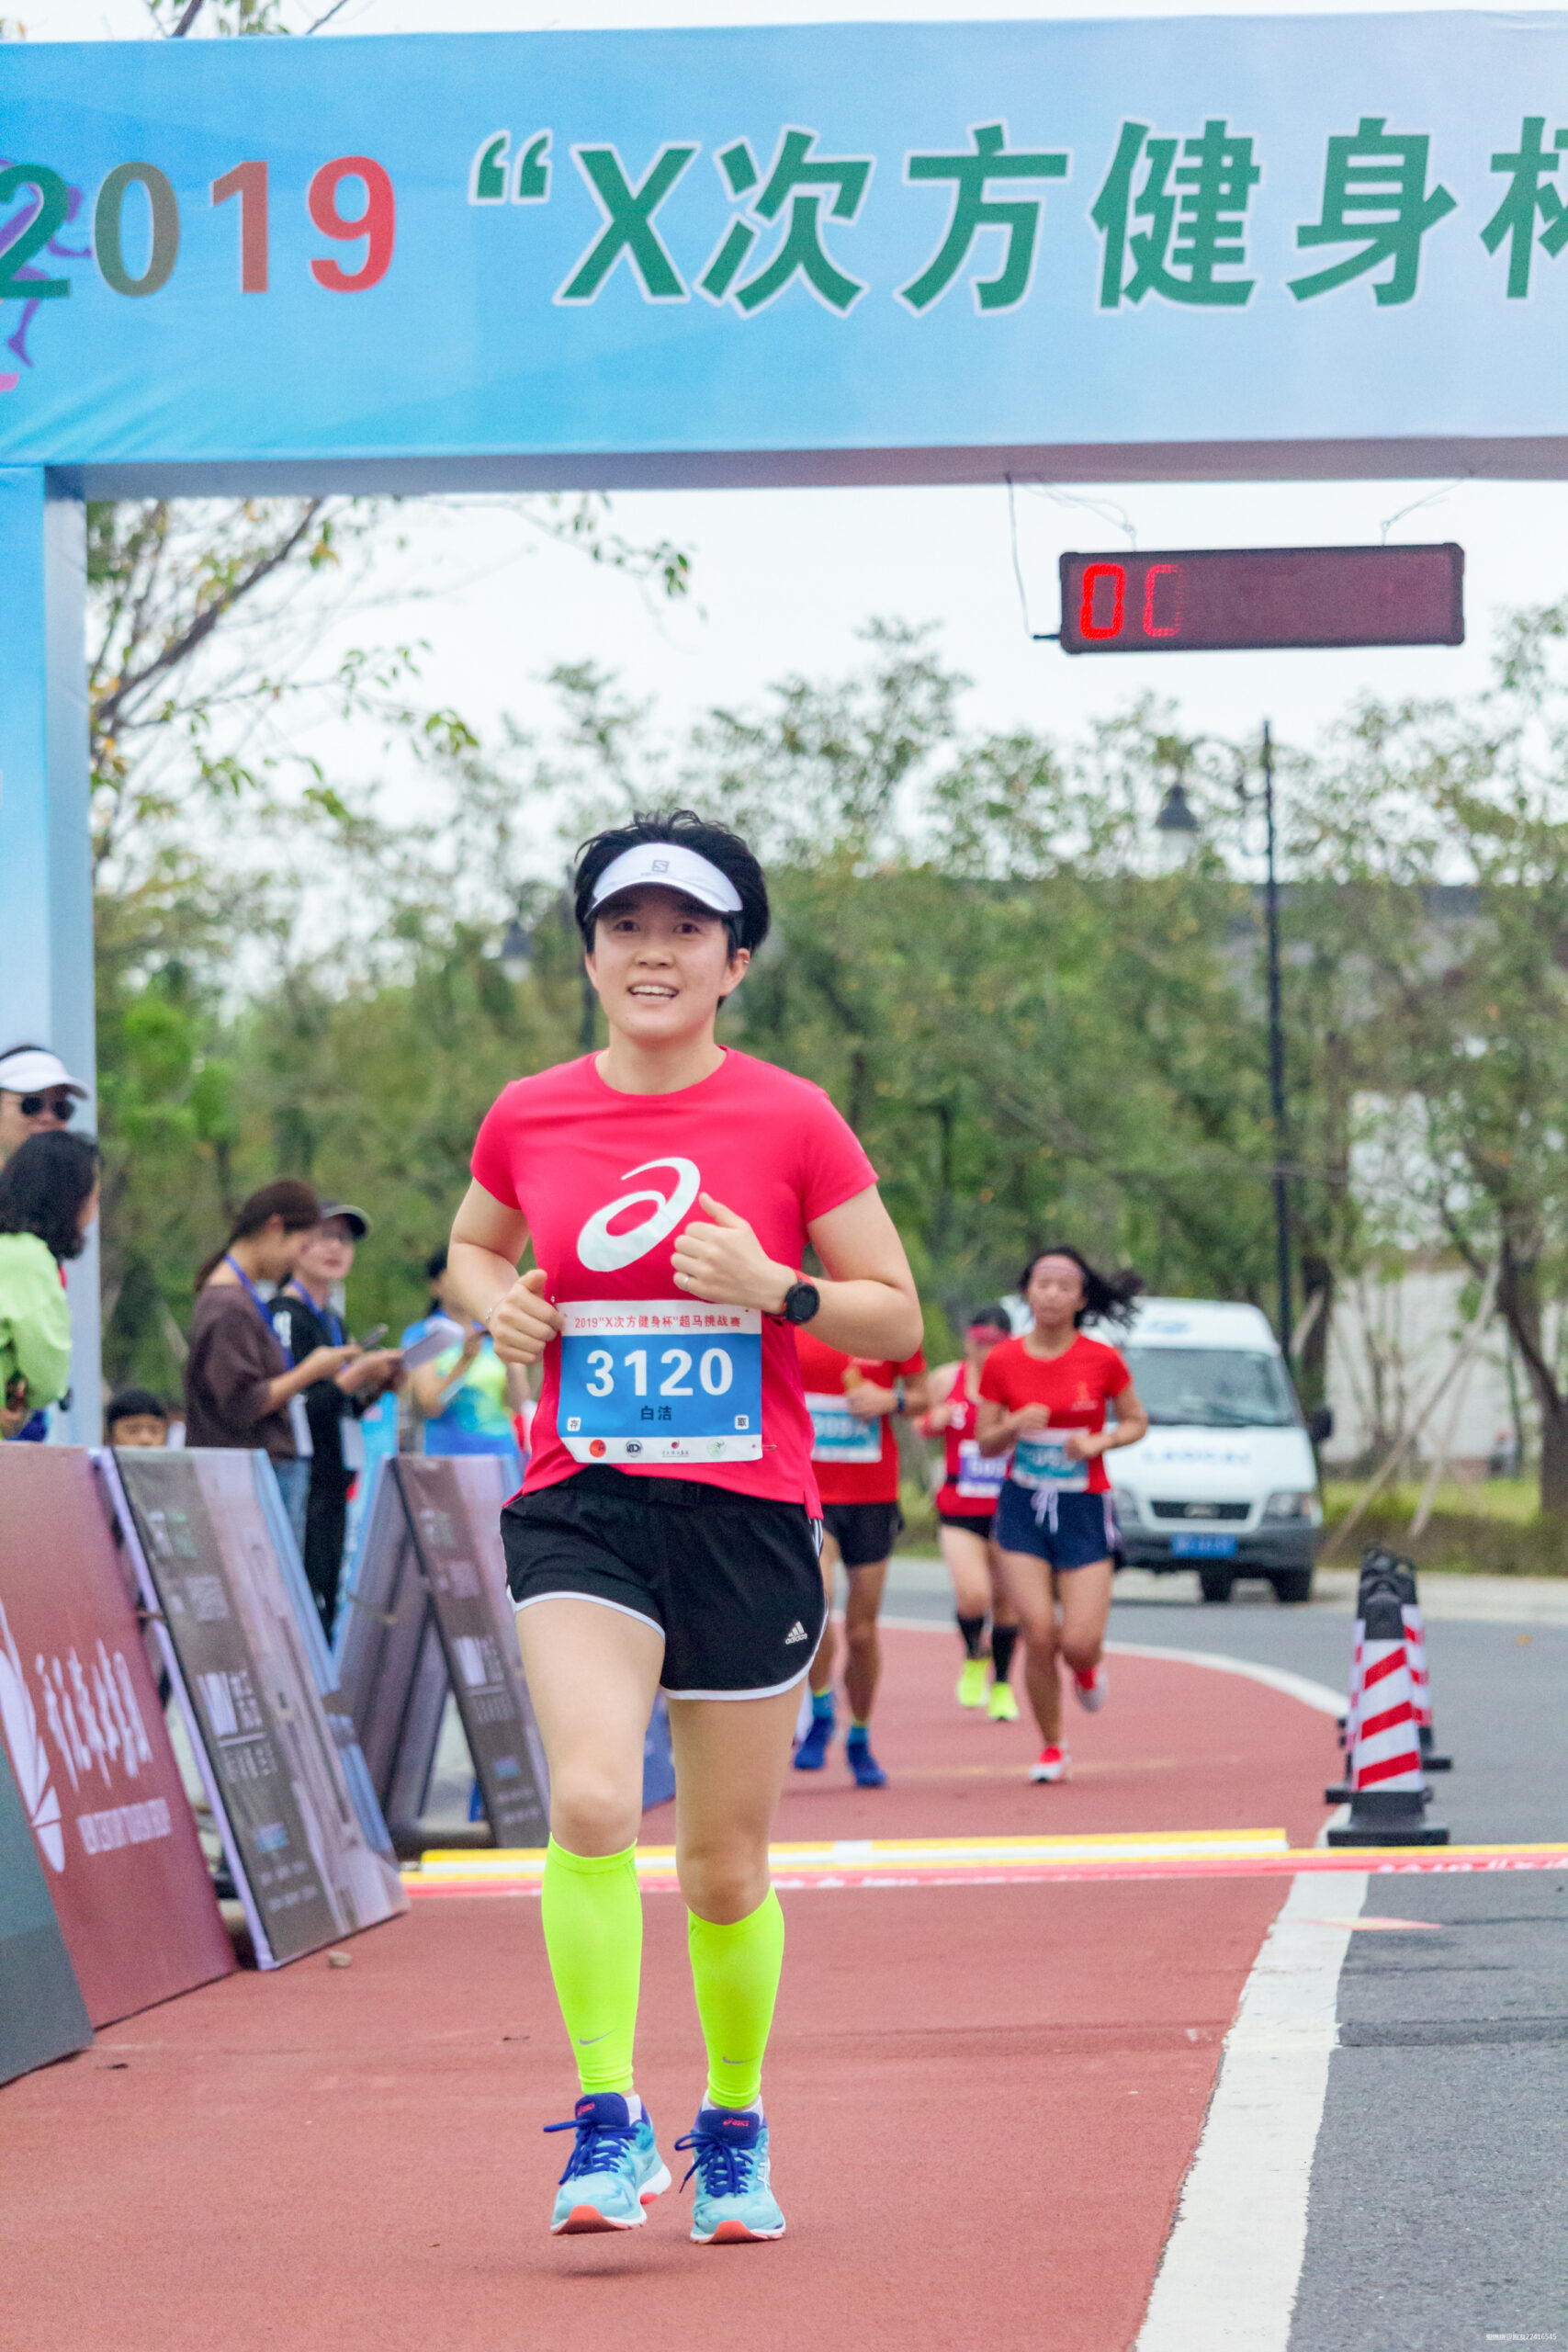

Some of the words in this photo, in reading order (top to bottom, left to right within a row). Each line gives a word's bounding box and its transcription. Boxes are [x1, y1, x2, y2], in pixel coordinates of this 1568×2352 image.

[0, 155, 396, 299] 2019
[585, 1348, 734, 1397] 3120
[640, 1406, 672, 1421] 白洁
